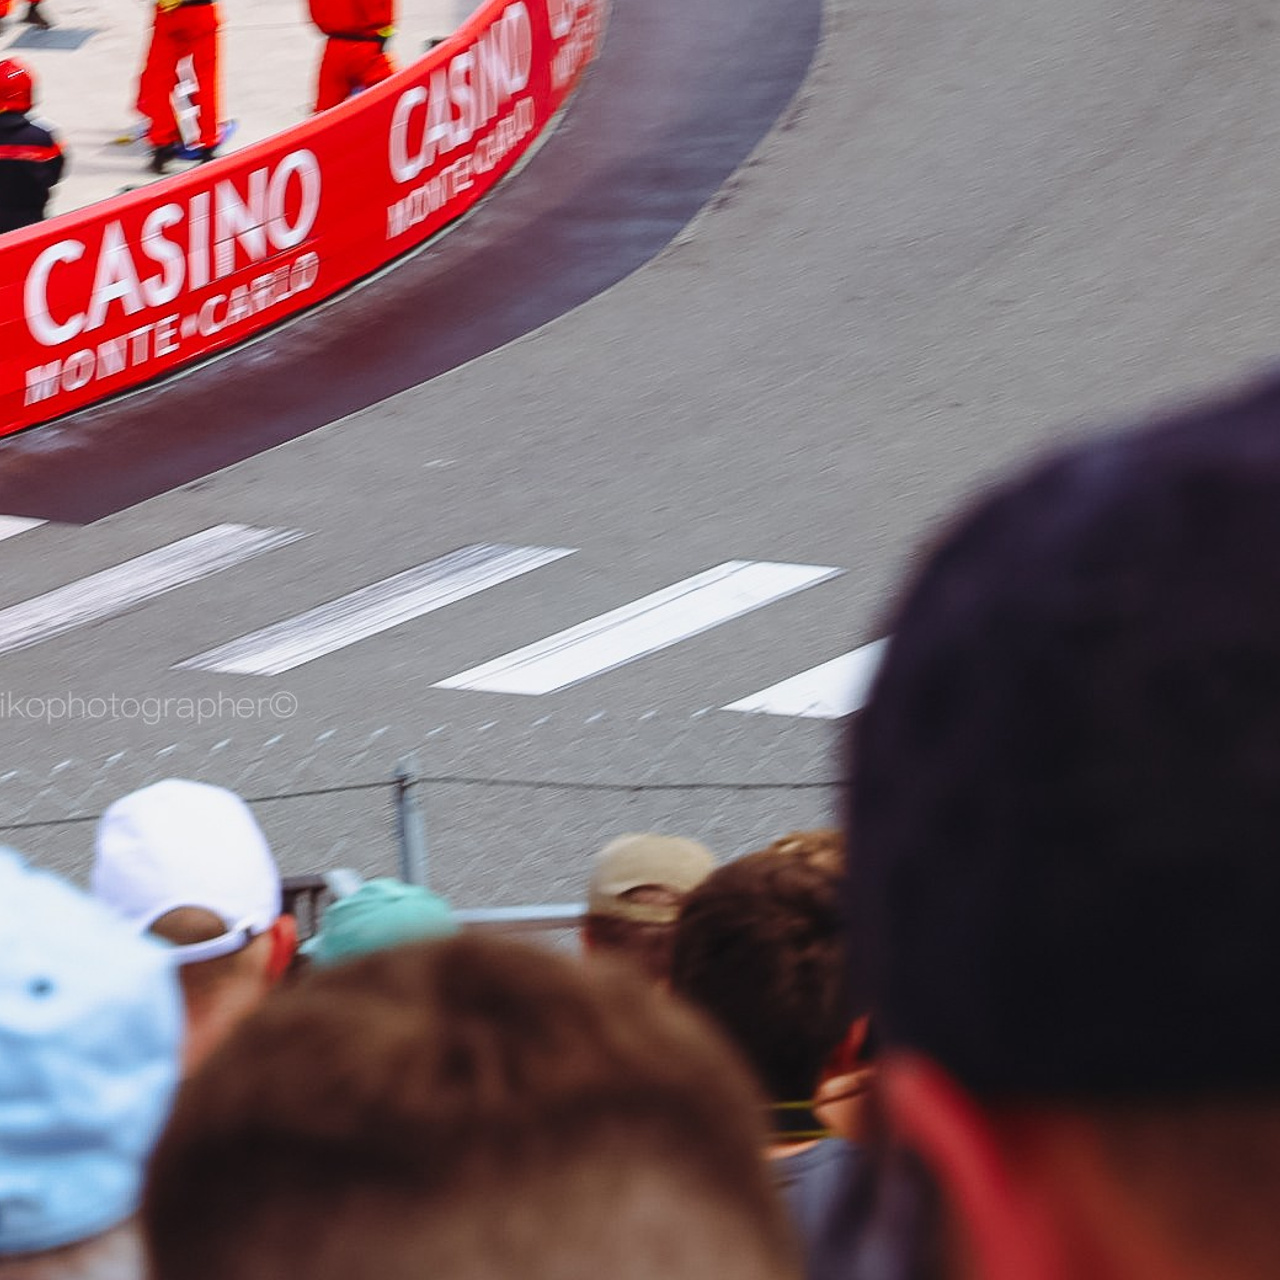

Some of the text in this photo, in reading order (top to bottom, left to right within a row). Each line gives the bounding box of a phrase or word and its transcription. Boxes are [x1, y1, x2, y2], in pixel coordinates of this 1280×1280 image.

[389, 1, 532, 184] CASINO
[24, 148, 321, 347] CASINO
[24, 251, 319, 407] MONTE CARLO
